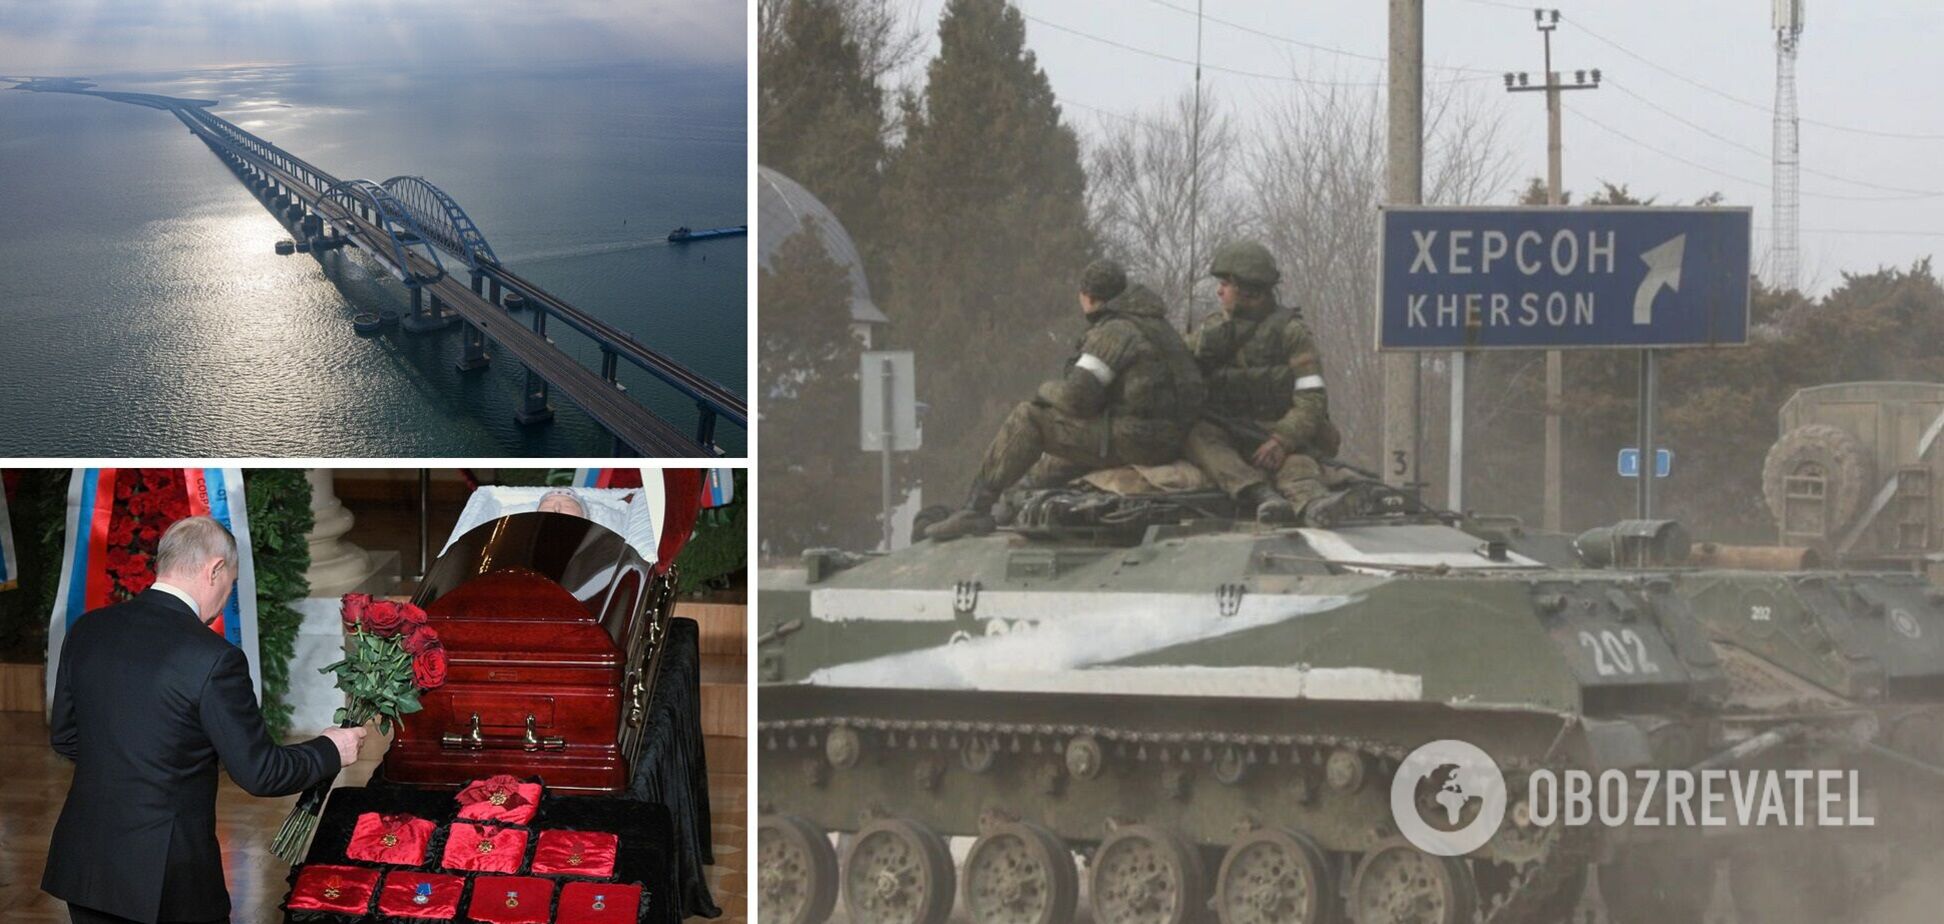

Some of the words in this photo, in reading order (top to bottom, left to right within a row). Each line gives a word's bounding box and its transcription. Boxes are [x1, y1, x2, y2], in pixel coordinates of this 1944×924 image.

[1408, 229, 1615, 276] ХЕРСОН
[1407, 291, 1595, 328] KHERSON
[1392, 450, 1408, 476] 3
[1751, 605, 1771, 621] 202
[1578, 628, 1660, 676] 202
